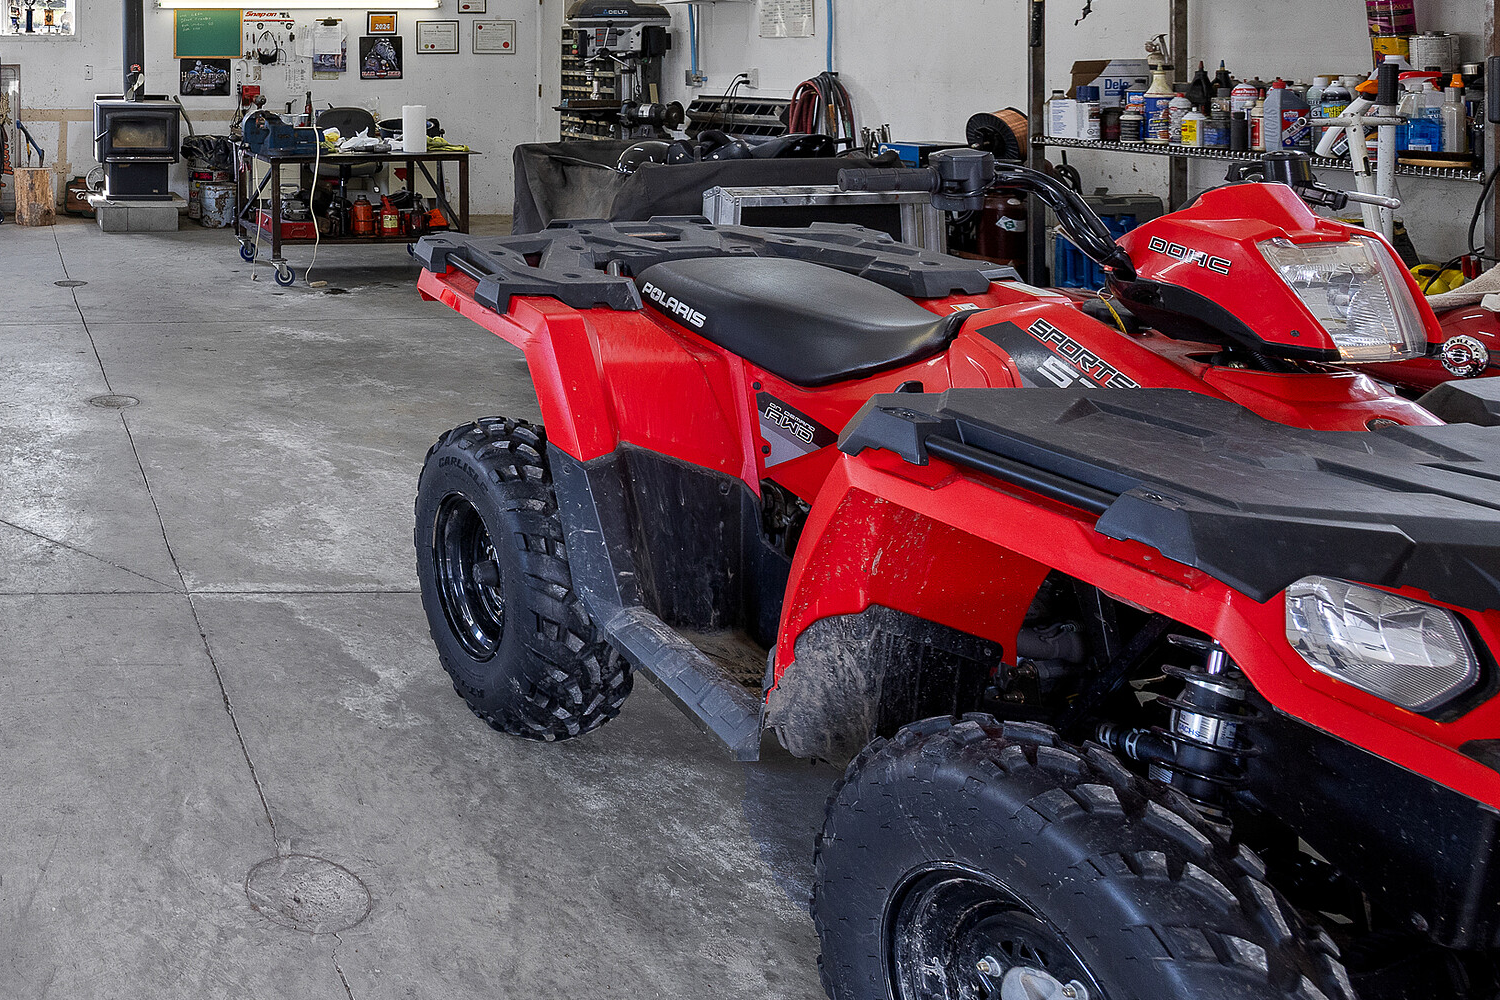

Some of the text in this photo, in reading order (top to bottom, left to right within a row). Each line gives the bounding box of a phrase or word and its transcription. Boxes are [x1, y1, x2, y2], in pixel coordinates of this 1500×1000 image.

[245, 10, 278, 18] Snap-on
[1147, 235, 1232, 276] DOHC
[641, 281, 707, 328] POLARIS
[1027, 317, 1142, 389] SPORTS
[764, 406, 814, 444] AWD
[769, 402, 816, 432] ON DEMAND
